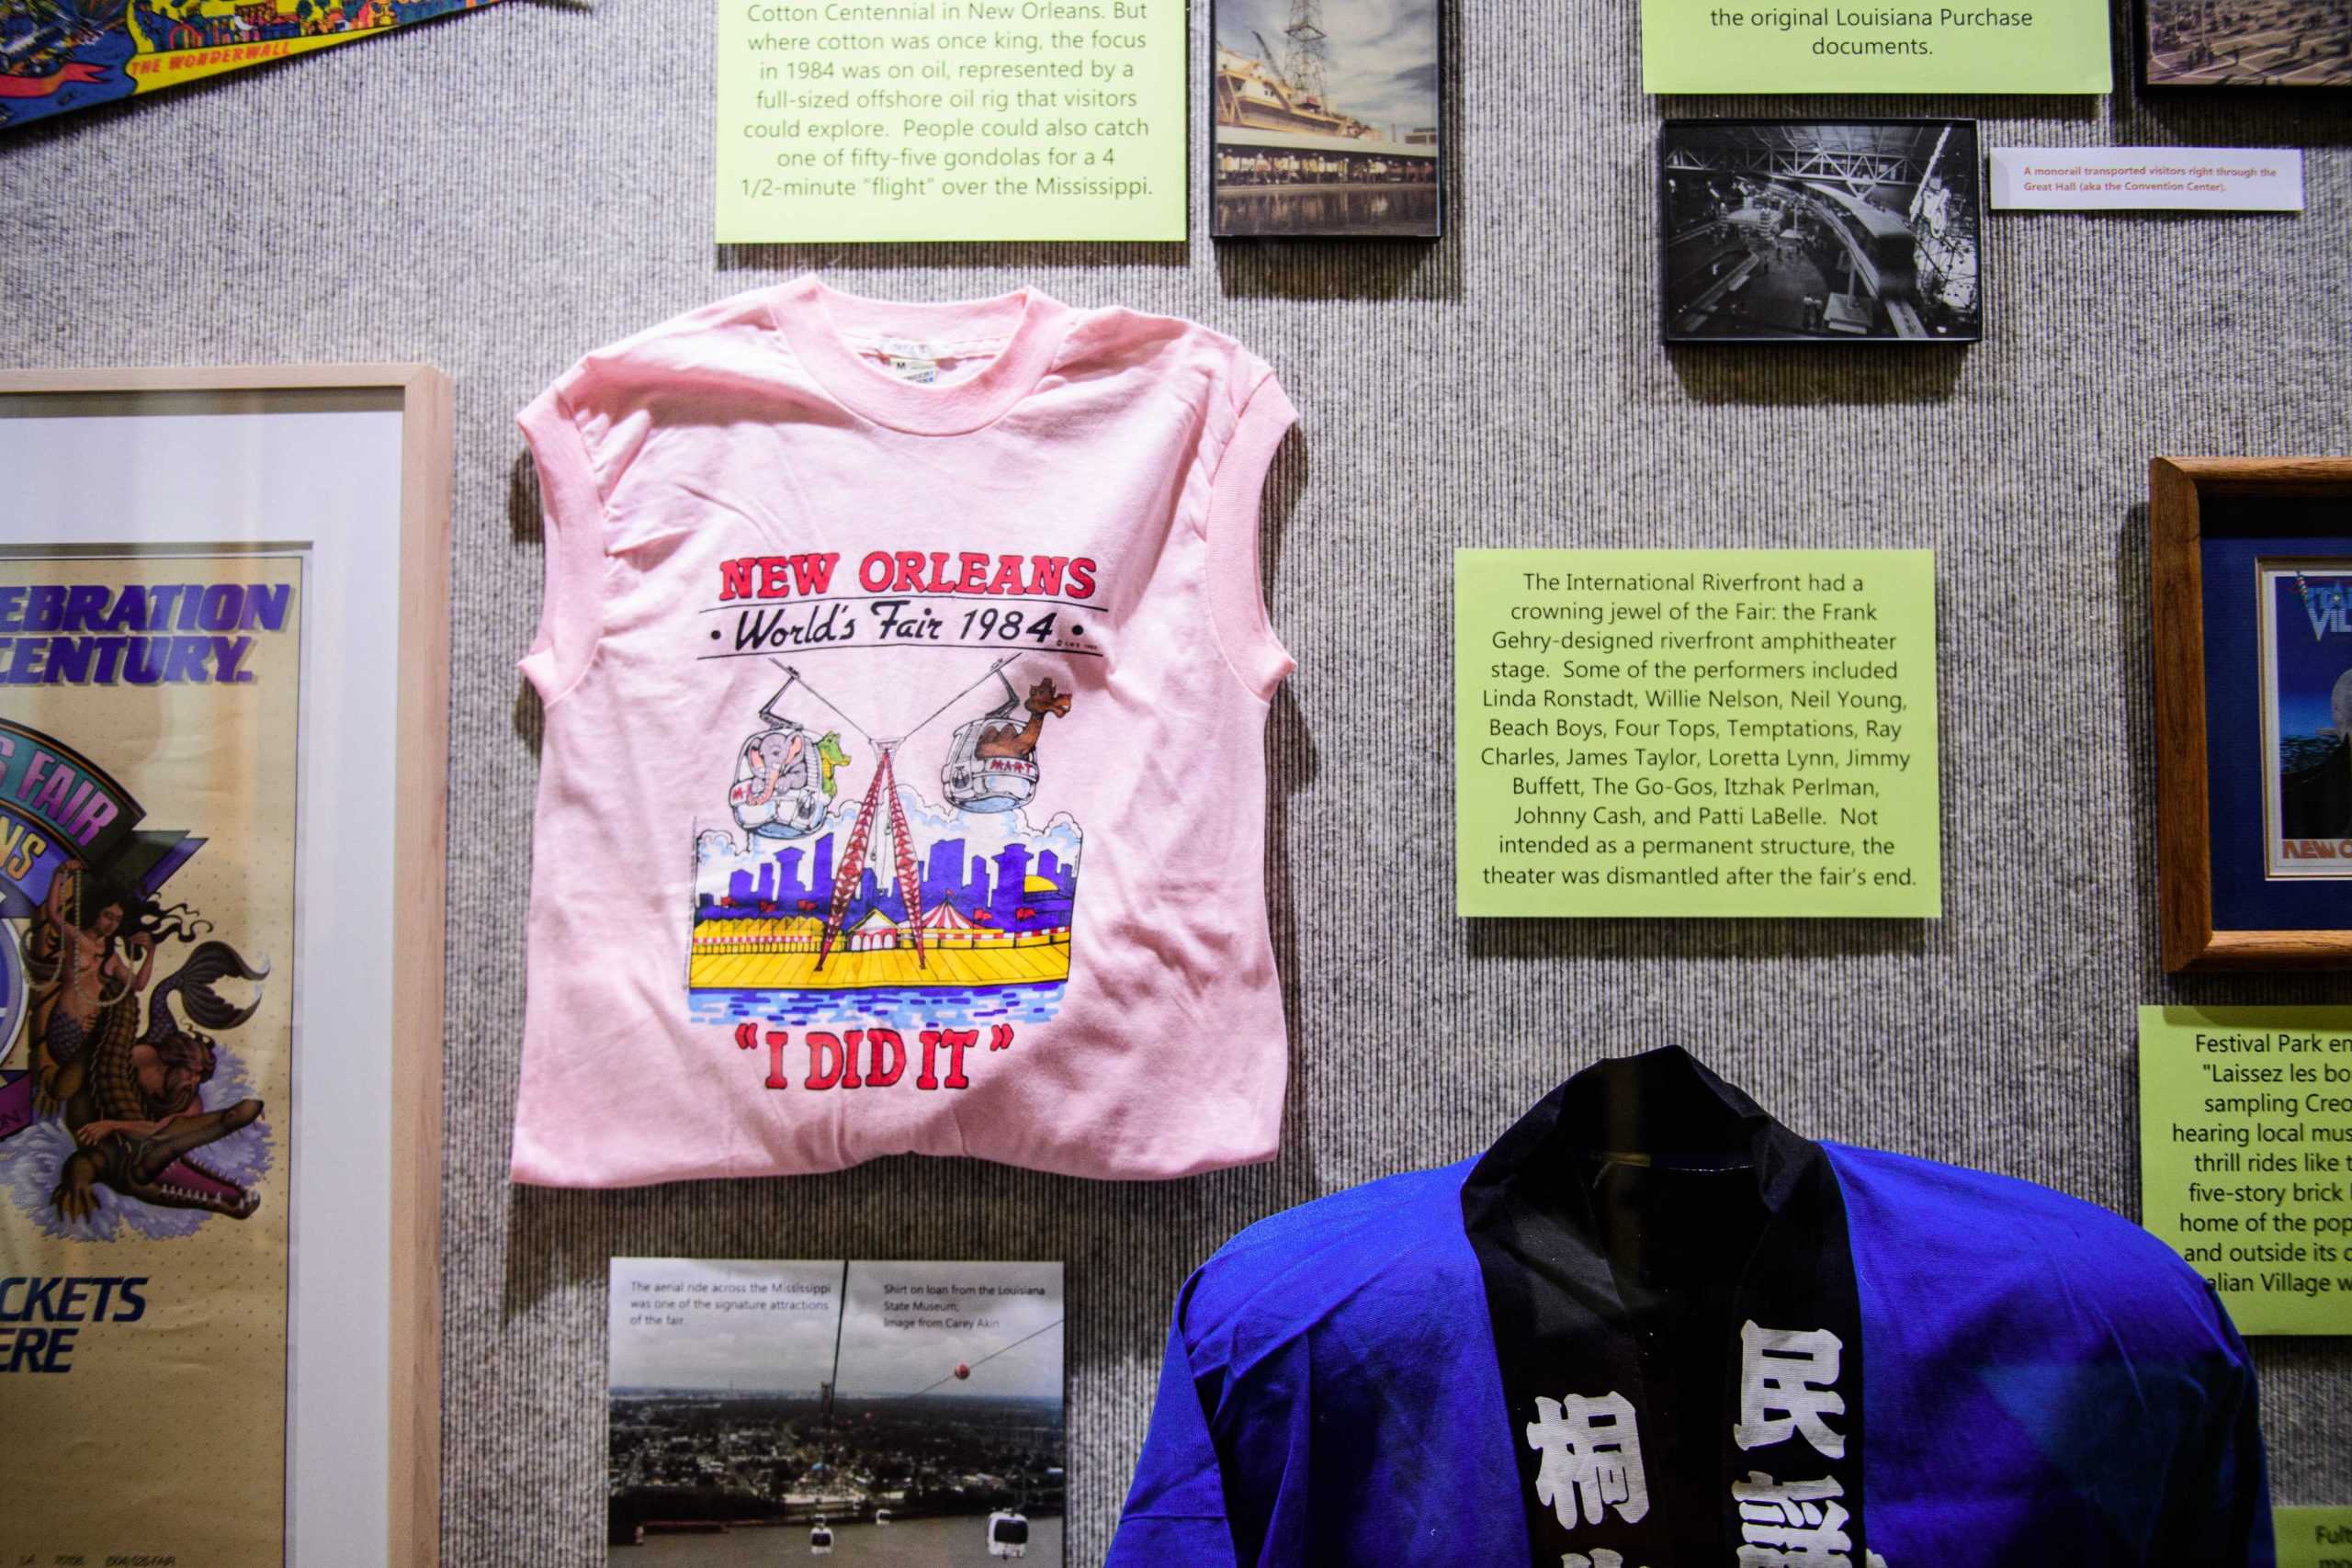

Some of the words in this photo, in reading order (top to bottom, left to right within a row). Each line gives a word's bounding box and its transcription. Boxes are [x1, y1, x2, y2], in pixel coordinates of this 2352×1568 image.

[747, 4, 818, 23] Cotton
[824, 2, 934, 22] Centennial
[942, 2, 961, 20] in
[967, 2, 1015, 20] New
[1021, 1, 1105, 20] Orleans.
[1113, 0, 1148, 20] But
[1710, 7, 1744, 27] the
[1750, 7, 1828, 30] original
[1837, 7, 1933, 27] Louisiana
[1940, 7, 2033, 27] Purchase
[747, 32, 811, 51] where
[816, 33, 885, 51] cotton
[890, 36, 931, 50] was
[936, 35, 988, 50] once
[994, 30, 1043, 55] king,
[1050, 29, 1084, 50] the
[1091, 28, 1147, 49] focus
[1812, 36, 1933, 55] documents.
[130, 61, 163, 75] THE
[760, 62, 778, 80] in
[786, 61, 835, 80] 1984
[842, 65, 881, 80] was
[887, 65, 914, 80] on
[921, 60, 951, 81] oil,
[958, 59, 1083, 83] represented
[1091, 58, 1116, 84] by
[1122, 63, 1135, 78] a
[756, 89, 850, 109] full-sized
[856, 88, 944, 109] offshore
[949, 88, 975, 108] oil
[981, 88, 1009, 113] rig
[1015, 88, 1058, 108] that
[1063, 88, 1137, 107] visitors
[743, 118, 800, 139] could
[807, 118, 889, 142] explore.
[903, 118, 975, 142] People
[980, 117, 1039, 137] could
[1045, 117, 1088, 137] also
[1094, 117, 1149, 137] catch
[2023, 165, 2032, 176] A
[2033, 165, 2082, 176] monorail
[2084, 165, 2147, 177] transported
[2148, 165, 2188, 176] visitors
[2188, 165, 2214, 179] right
[2215, 166, 2258, 179] through
[2259, 167, 2278, 177] the
[741, 177, 856, 198] 1/2-minute
[864, 175, 934, 201] "flight"
[941, 181, 989, 196] over
[994, 175, 1028, 196] the
[1035, 175, 1153, 200] Mississippi.
[2022, 181, 2052, 192] Great
[2054, 181, 2077, 192] Hall
[2078, 181, 2102, 193] (aka
[2104, 181, 2122, 191] the
[2123, 181, 2185, 191] Convention
[719, 553, 840, 601] NEW
[859, 551, 1096, 599] ORLEANS
[1522, 572, 1561, 592] The
[1566, 572, 1694, 592] International
[1702, 572, 1802, 592] Riverfront
[1808, 572, 1846, 592] had
[1852, 578, 1863, 592] a
[735, 603, 856, 650] World's
[871, 600, 944, 640] Fair
[959, 610, 1057, 643] 1984
[1492, 630, 1654, 654] Gehry-designed
[1660, 630, 1755, 650] riverfront
[1760, 631, 1897, 654] amphitheater
[1483, 688, 1536, 707] Linda
[1544, 689, 1638, 710] Ronstadt,
[1645, 689, 1702, 708] Willie
[1708, 690, 1783, 710] Nelson,
[1791, 690, 1830, 708] Neil
[1837, 690, 1907, 713] Young,
[1489, 717, 1549, 737] Beach
[1556, 718, 1608, 742] Boys,
[1615, 718, 1661, 738] Four
[1666, 718, 1720, 742] Tops,
[1726, 718, 1859, 742] Temptations,
[1866, 719, 1903, 742] Ray
[1480, 746, 1559, 768] Charles,
[1566, 748, 1628, 766] James
[1634, 747, 1701, 771] Taylor,
[1709, 749, 1780, 767] Loretta
[1787, 749, 1838, 771] Lynn,
[1846, 749, 1911, 771] Jimmy
[16, 749, 119, 848] FAIR
[1513, 775, 1585, 798] Buffett,
[1591, 776, 1629, 795] The
[1635, 776, 1717, 797] Go-Gos,
[1724, 776, 1786, 796] Itzhak
[1792, 777, 1880, 798] Perlman,
[1482, 865, 1556, 885] theater
[1561, 870, 1600, 886] was
[1606, 865, 1719, 886] dismantled
[1725, 865, 1774, 886] after
[1780, 866, 1813, 886] the
[1819, 866, 1867, 886] fair's
[1873, 866, 1917, 886] end.
[2195, 1033, 2271, 1054] Festival
[2277, 1033, 2324, 1054] Park
[804, 1028, 907, 1090] DID
[2202, 1063, 2284, 1083] "Laissez
[2290, 1063, 2318, 1083] les
[2204, 1092, 2299, 1117] sampling
[2172, 1122, 2250, 1148] hearing
[2256, 1122, 2304, 1143] local
[2193, 1152, 2241, 1173] thrill
[2248, 1152, 2298, 1173] rides
[2304, 1152, 2340, 1172] like
[2188, 1181, 2287, 1207] five-story
[2292, 1182, 2345, 1202] brick
[2179, 1212, 2240, 1233] home
[2245, 1212, 2267, 1233] of
[2271, 1212, 2307, 1233] the
[2182, 1242, 2222, 1264] and
[2229, 1241, 2307, 1263] outside
[2312, 1242, 2337, 1262] its
[2259, 1271, 2331, 1297] Village
